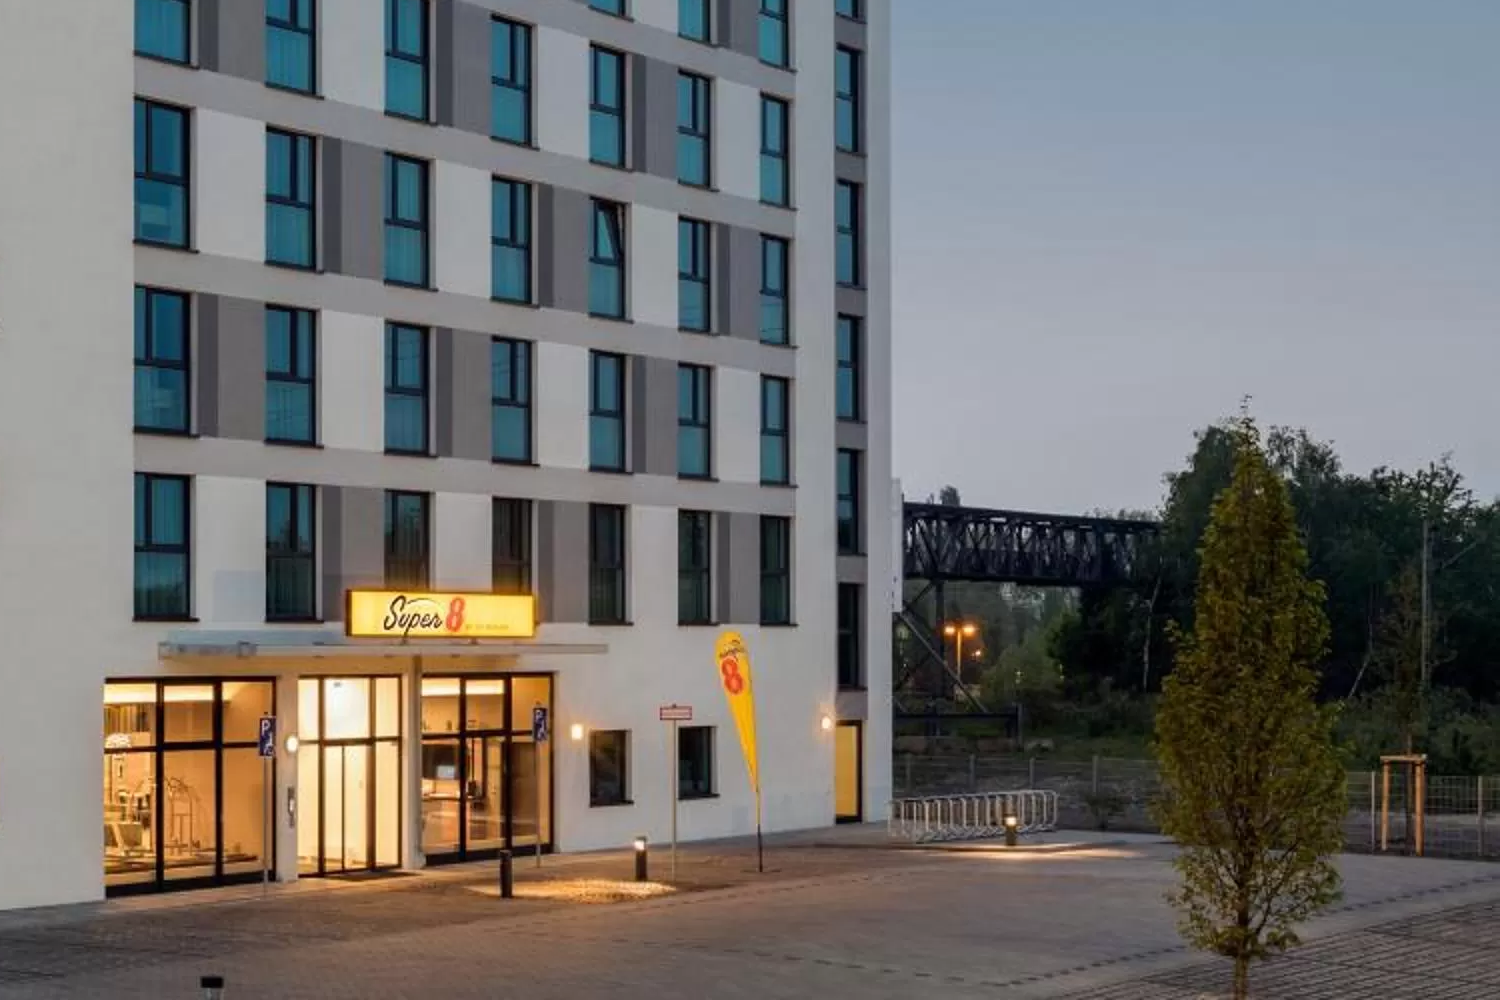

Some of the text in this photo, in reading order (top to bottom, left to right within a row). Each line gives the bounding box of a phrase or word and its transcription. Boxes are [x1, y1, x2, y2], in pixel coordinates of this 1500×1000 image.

[383, 594, 466, 639] Super 8
[721, 658, 744, 695] 8
[261, 719, 271, 737] P
